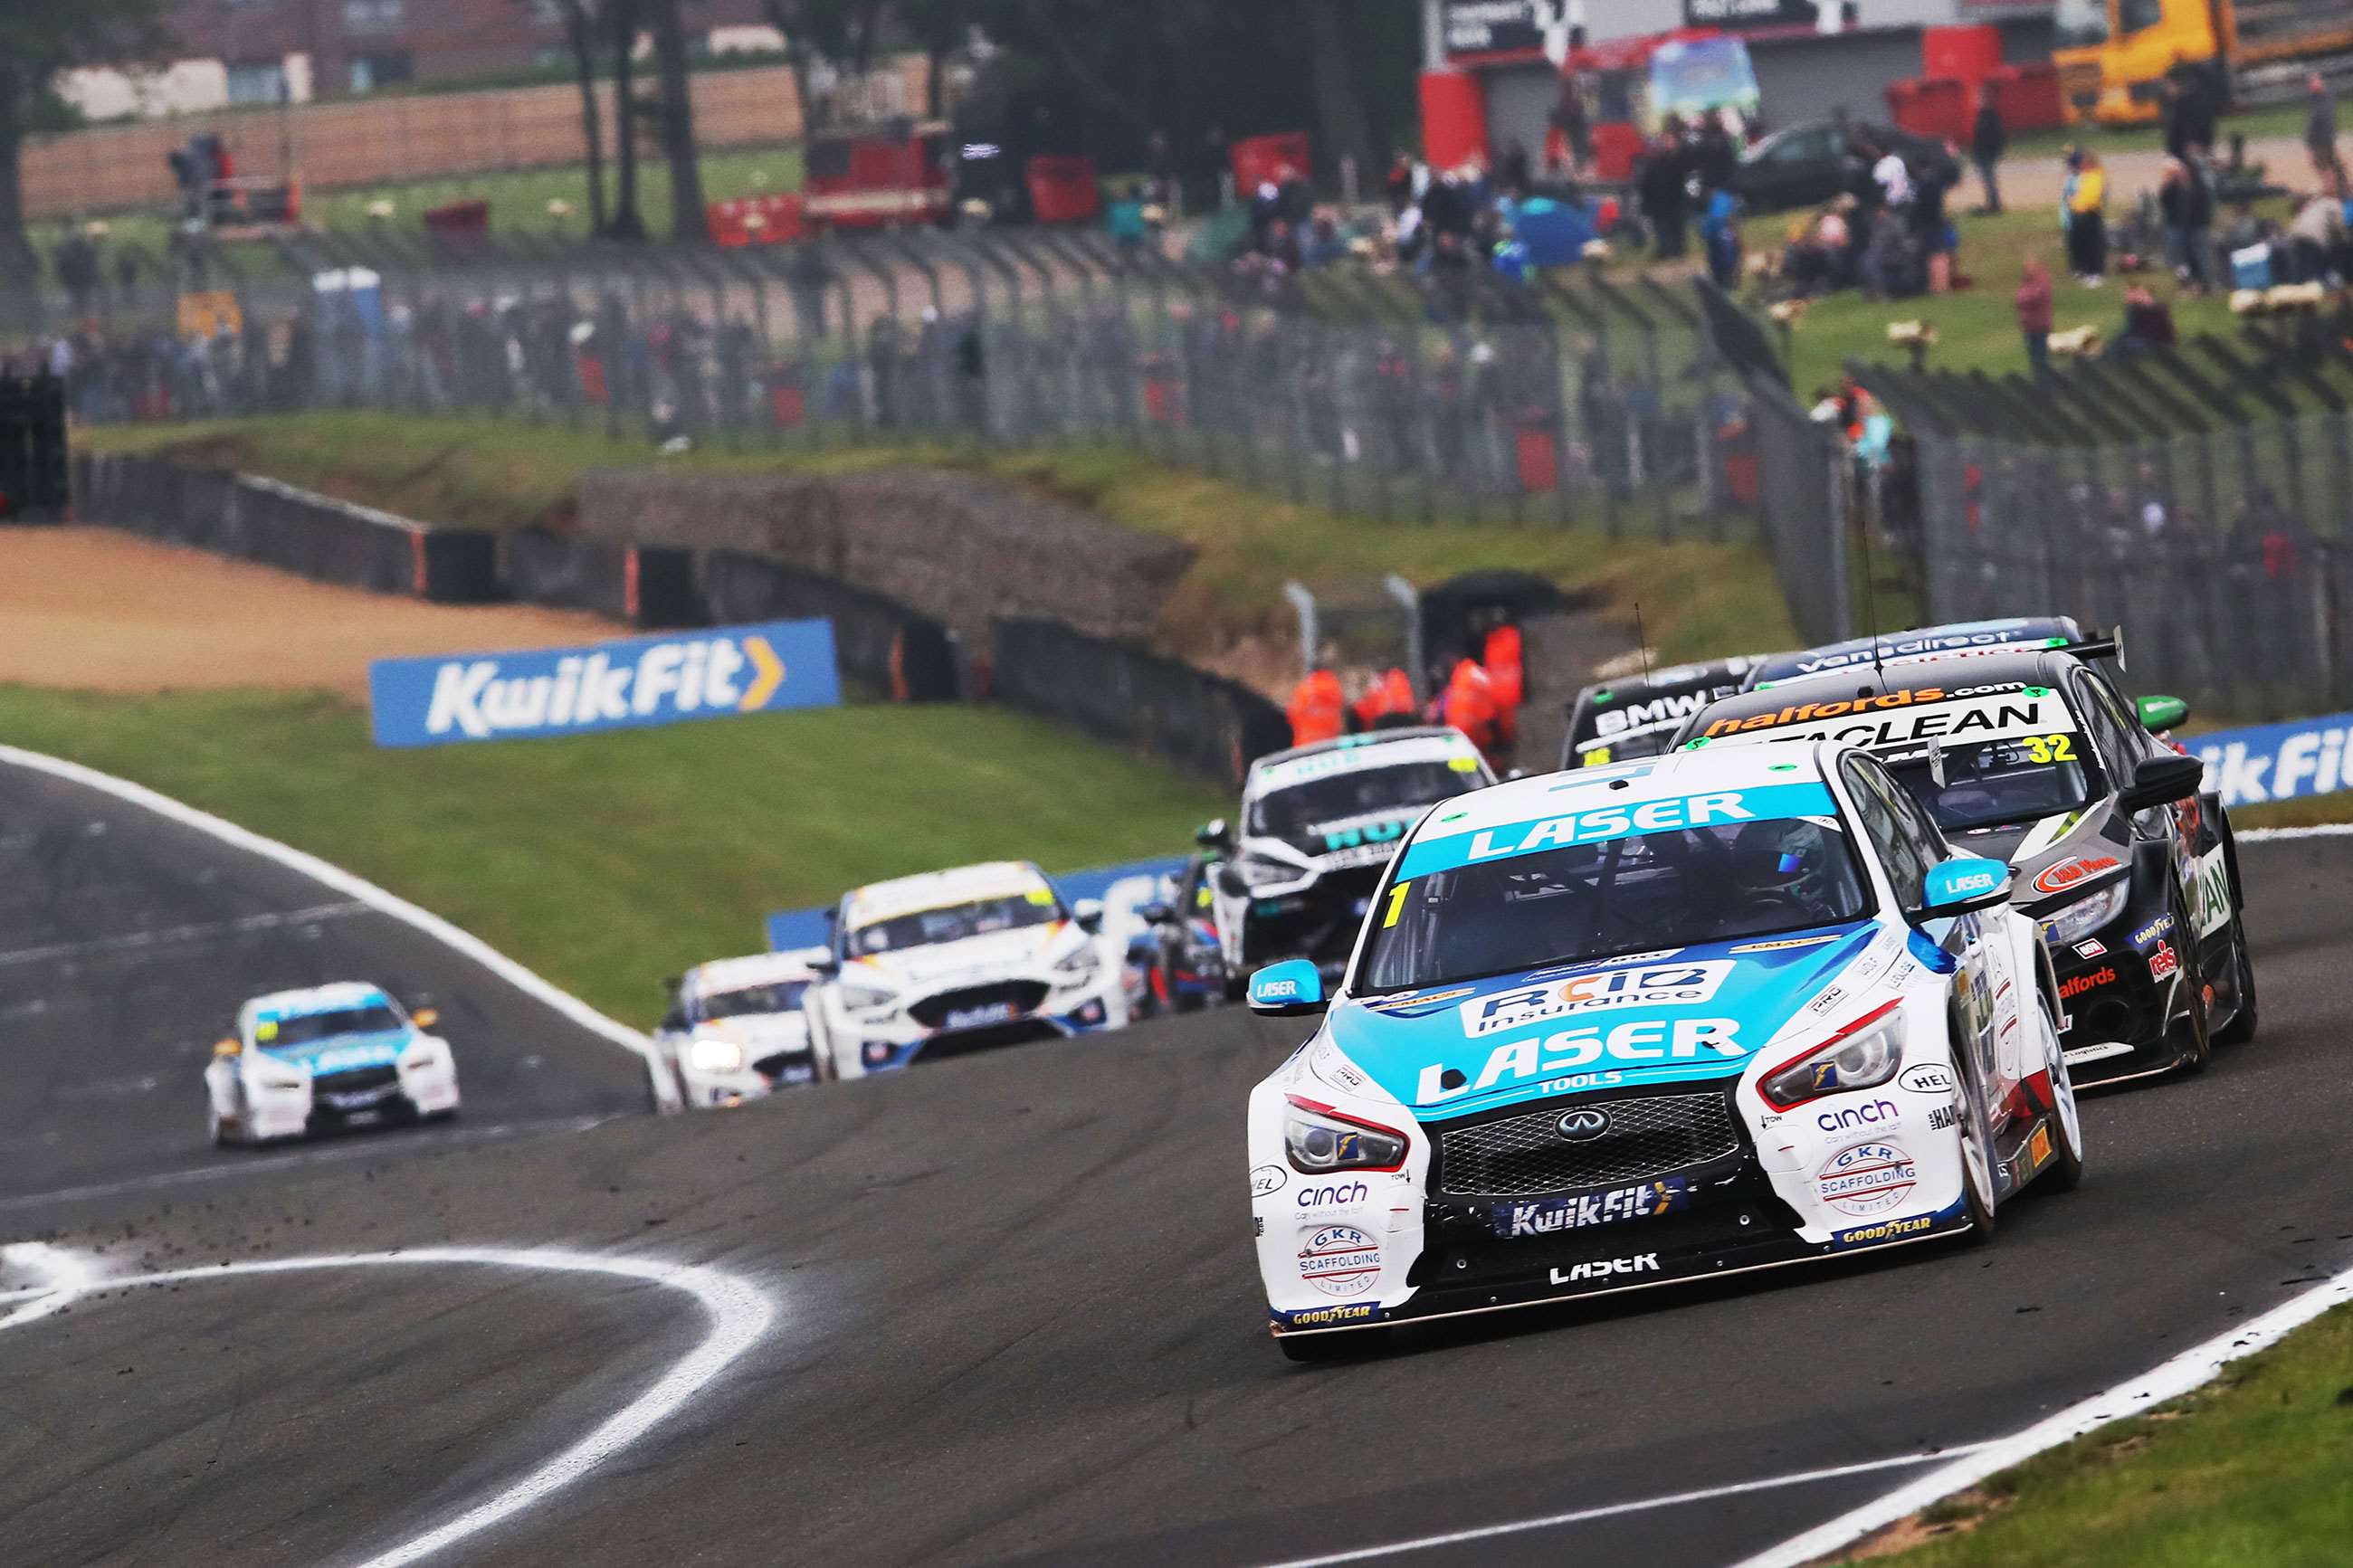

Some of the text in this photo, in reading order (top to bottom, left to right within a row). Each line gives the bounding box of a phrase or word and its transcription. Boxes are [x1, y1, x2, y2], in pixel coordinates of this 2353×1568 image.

[425, 635, 745, 738] KwikFit
[2022, 734, 2078, 764] 32
[1467, 792, 1757, 860] LASER
[1945, 873, 1996, 894] LASER
[1383, 880, 1412, 929] 1
[1257, 980, 1297, 997] LASER
[2057, 966, 2116, 1000] alfords
[1415, 1017, 1748, 1106] LASER
[1538, 1070, 1624, 1094] TOOLS
[1913, 1074, 1951, 1088] HEL
[1818, 1099, 1900, 1132] cinch
[1837, 1146, 1892, 1167] GKR
[1821, 1167, 1916, 1193] SCAFFOLDING
[1297, 1181, 1368, 1207] cinch
[1510, 1184, 1651, 1237] KwikFit
[1314, 1229, 1362, 1246] GKR
[1843, 1217, 1931, 1243] GOODYEAR
[1300, 1252, 1381, 1271] SCAFFOLDING
[1293, 1305, 1372, 1325] GOODYEAR
